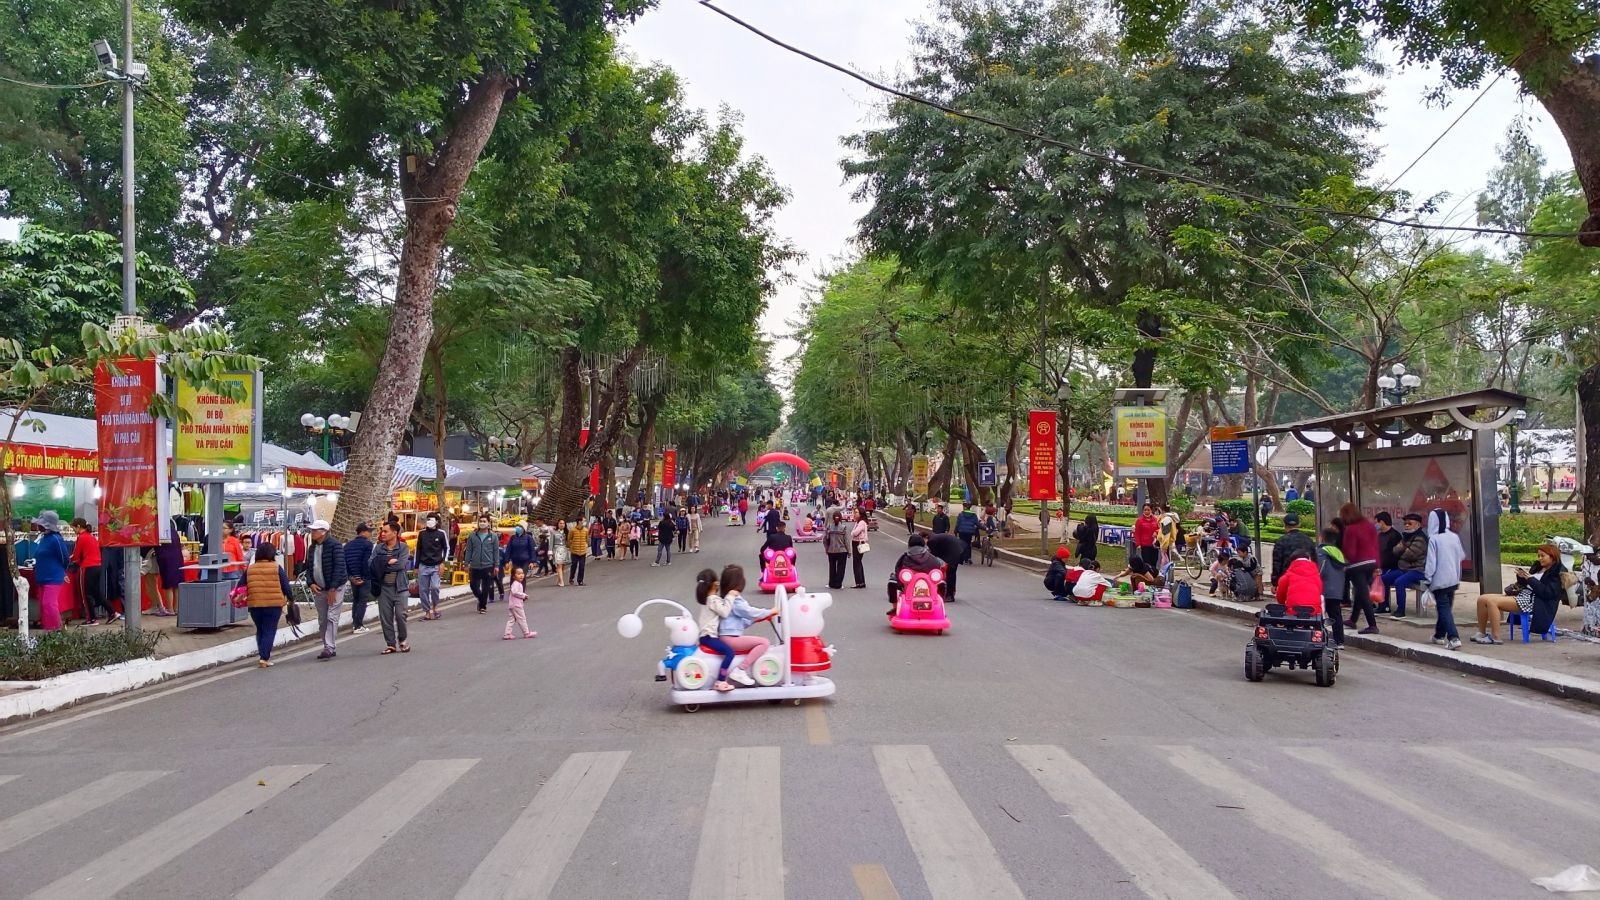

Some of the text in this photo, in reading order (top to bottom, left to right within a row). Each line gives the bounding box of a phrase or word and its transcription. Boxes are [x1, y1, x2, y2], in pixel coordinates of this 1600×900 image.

[197, 394, 218, 405] KHÔNG
[101, 411, 112, 426] PHỐ
[206, 409, 224, 421] ĐI BỘ
[180, 422, 249, 434] PHỐ TRẦN NHÂN TÔNG
[195, 437, 234, 451] VÀ PHỤ CẬN
[16, 454, 27, 467] CTY
[28, 453, 43, 469] THỜI
[44, 456, 64, 469] TRANG
[64, 455, 77, 473] VIỆT
[981, 467, 993, 481] P
